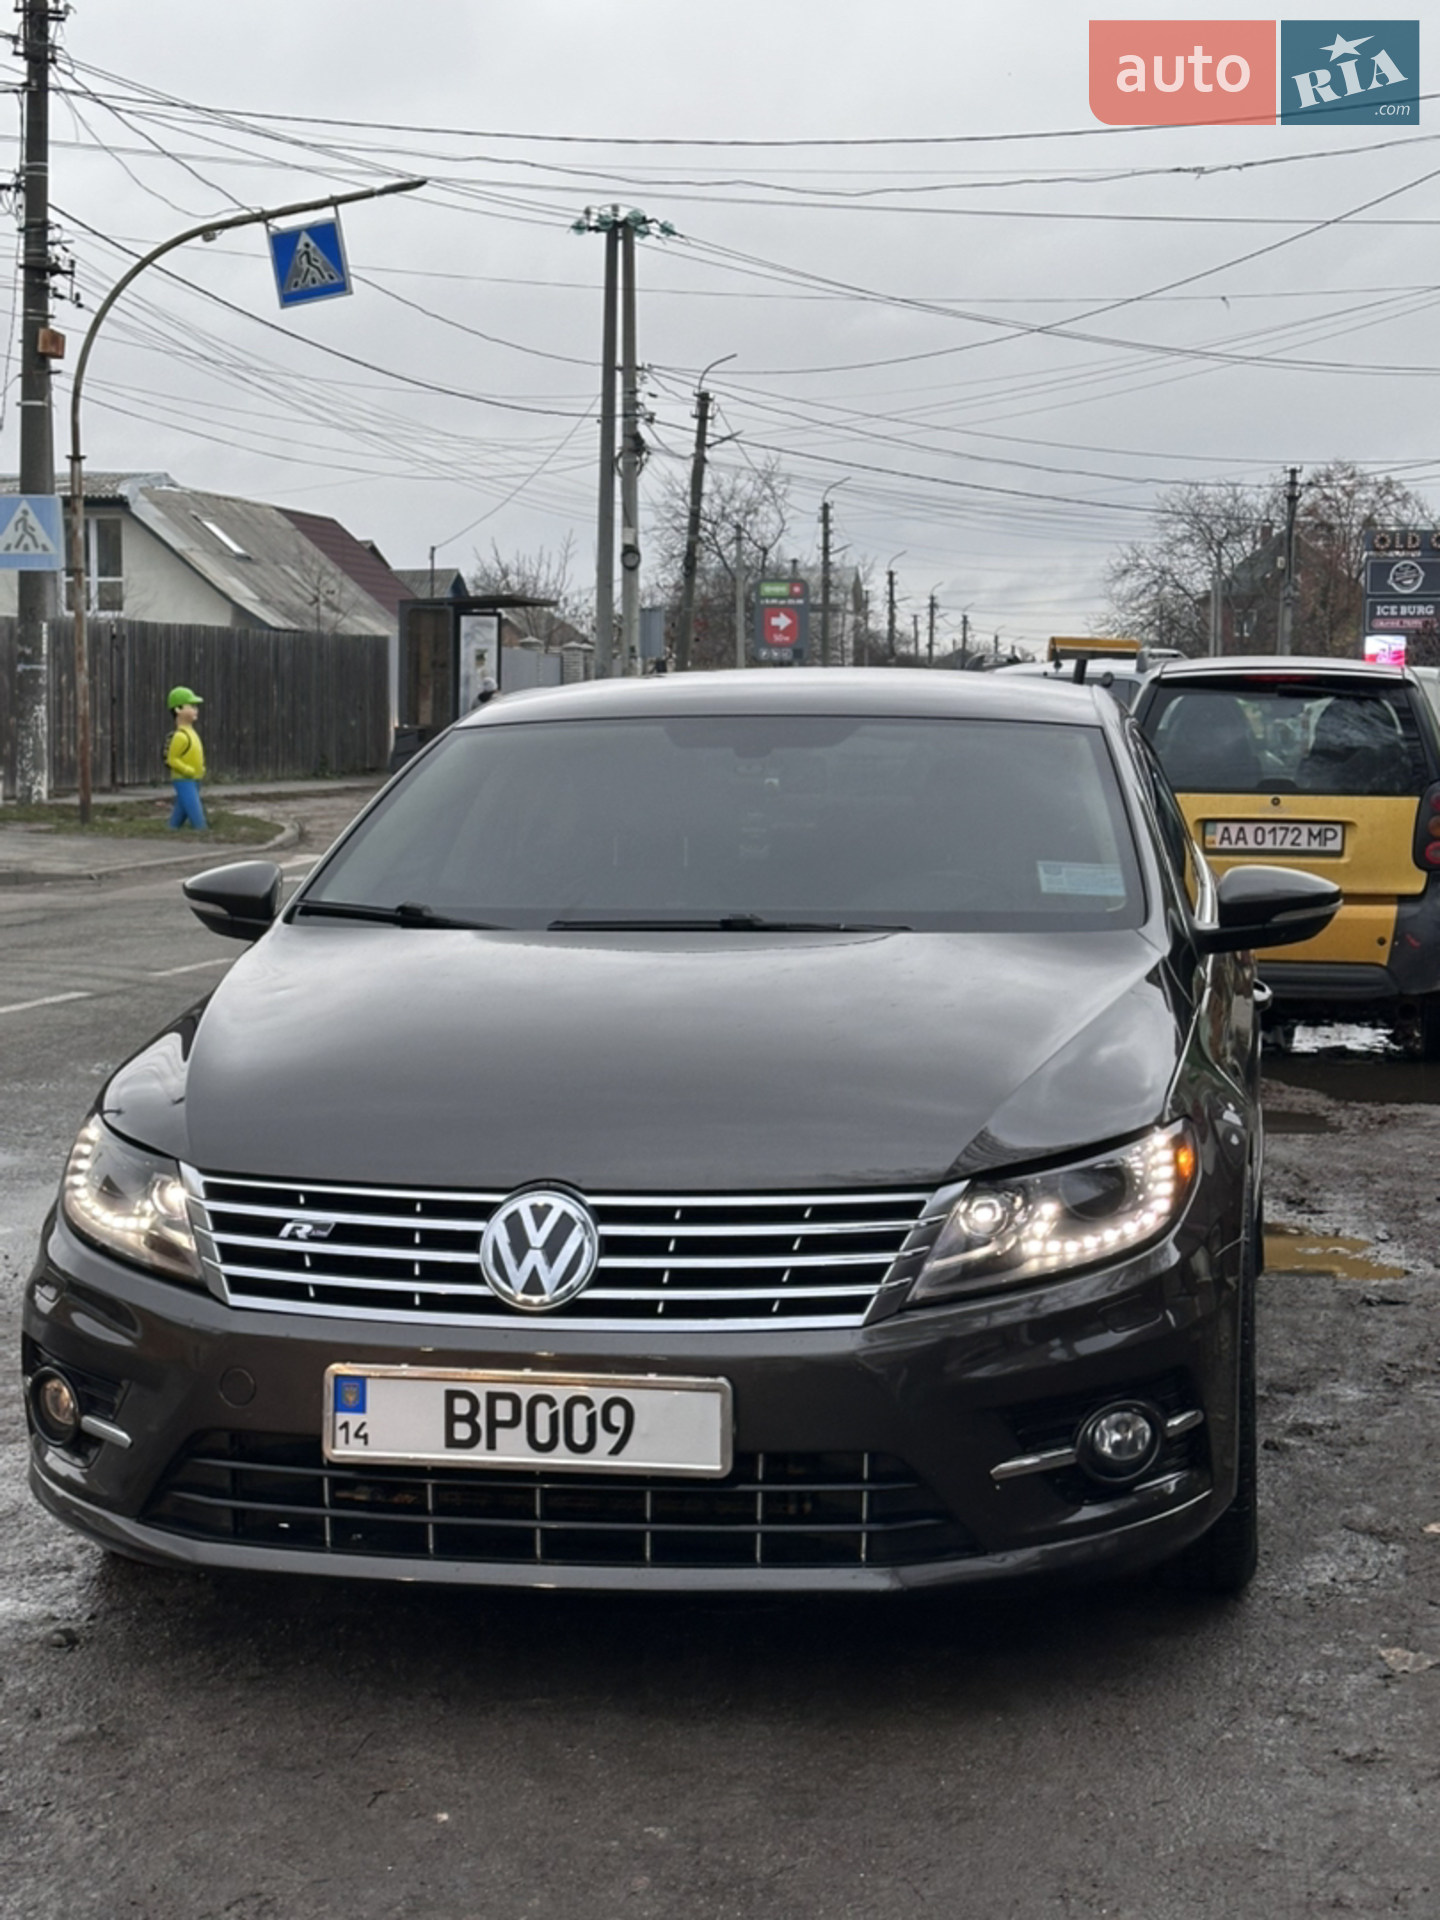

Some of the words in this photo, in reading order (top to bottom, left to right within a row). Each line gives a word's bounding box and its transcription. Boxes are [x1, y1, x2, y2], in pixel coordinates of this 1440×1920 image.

[1374, 532, 1421, 549] OLD
[1376, 605, 1398, 616] ICE
[1400, 604, 1435, 616] BURG
[1219, 826, 1248, 846] AA
[1253, 826, 1302, 847] 0172
[1307, 827, 1338, 848] MP
[338, 1420, 369, 1446] 14
[445, 1389, 635, 1456] BP009
